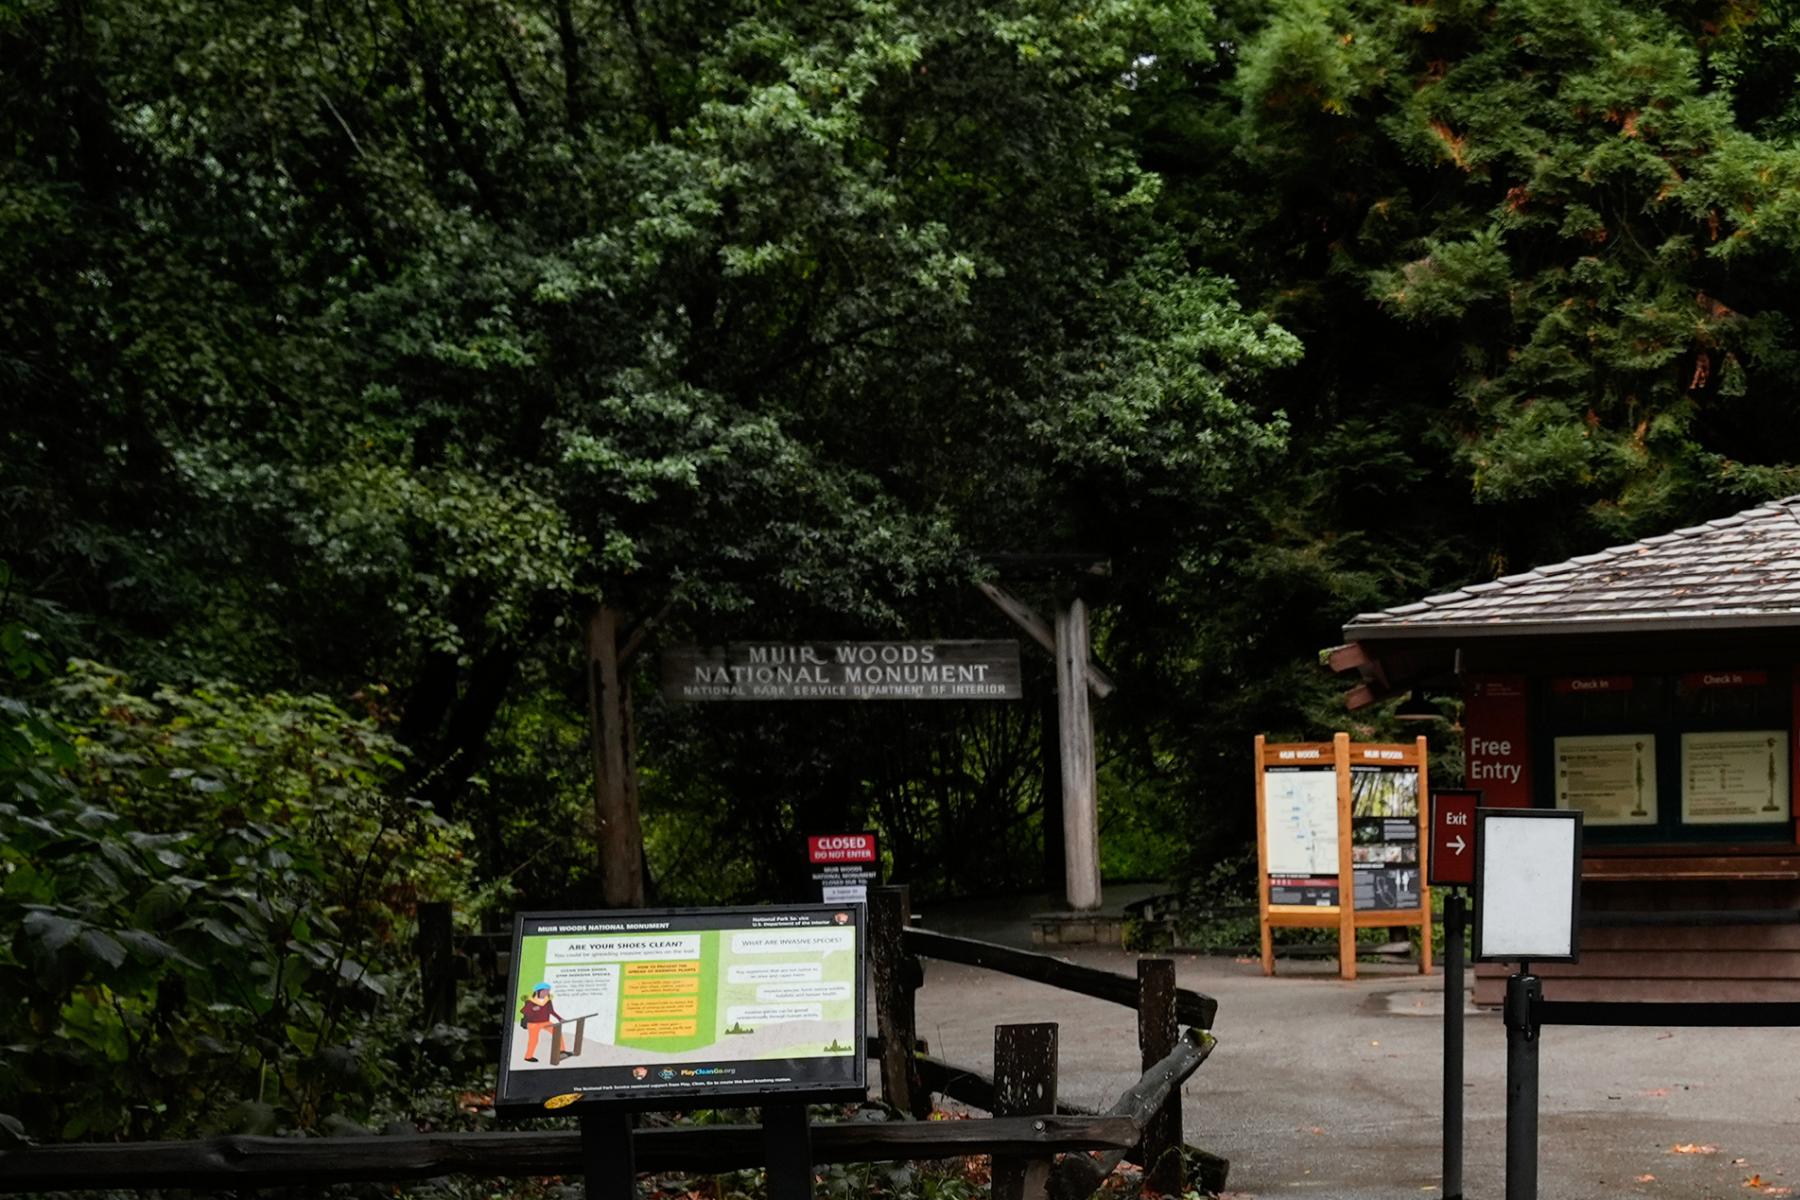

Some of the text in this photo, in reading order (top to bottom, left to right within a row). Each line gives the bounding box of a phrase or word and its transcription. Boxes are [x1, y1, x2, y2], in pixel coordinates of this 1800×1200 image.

[749, 645, 935, 664] MUIR WOODS
[694, 664, 989, 684] NATIONAL MONUMENT
[1704, 674, 1742, 684] Check In
[684, 684, 1006, 696] NATIONAL PARK SERVICE DEPARTMENT OF INTERIOR
[1572, 680, 1609, 690] Check In
[1471, 737, 1511, 755] Free
[1471, 761, 1521, 784] Entry
[1446, 812, 1467, 825] Exit
[818, 836, 867, 850] CLOSED
[815, 849, 872, 860] DO NOT ENTER
[626, 922, 670, 930] MONUMENT
[680, 1067, 736, 1078] PlayCleanGo.org
